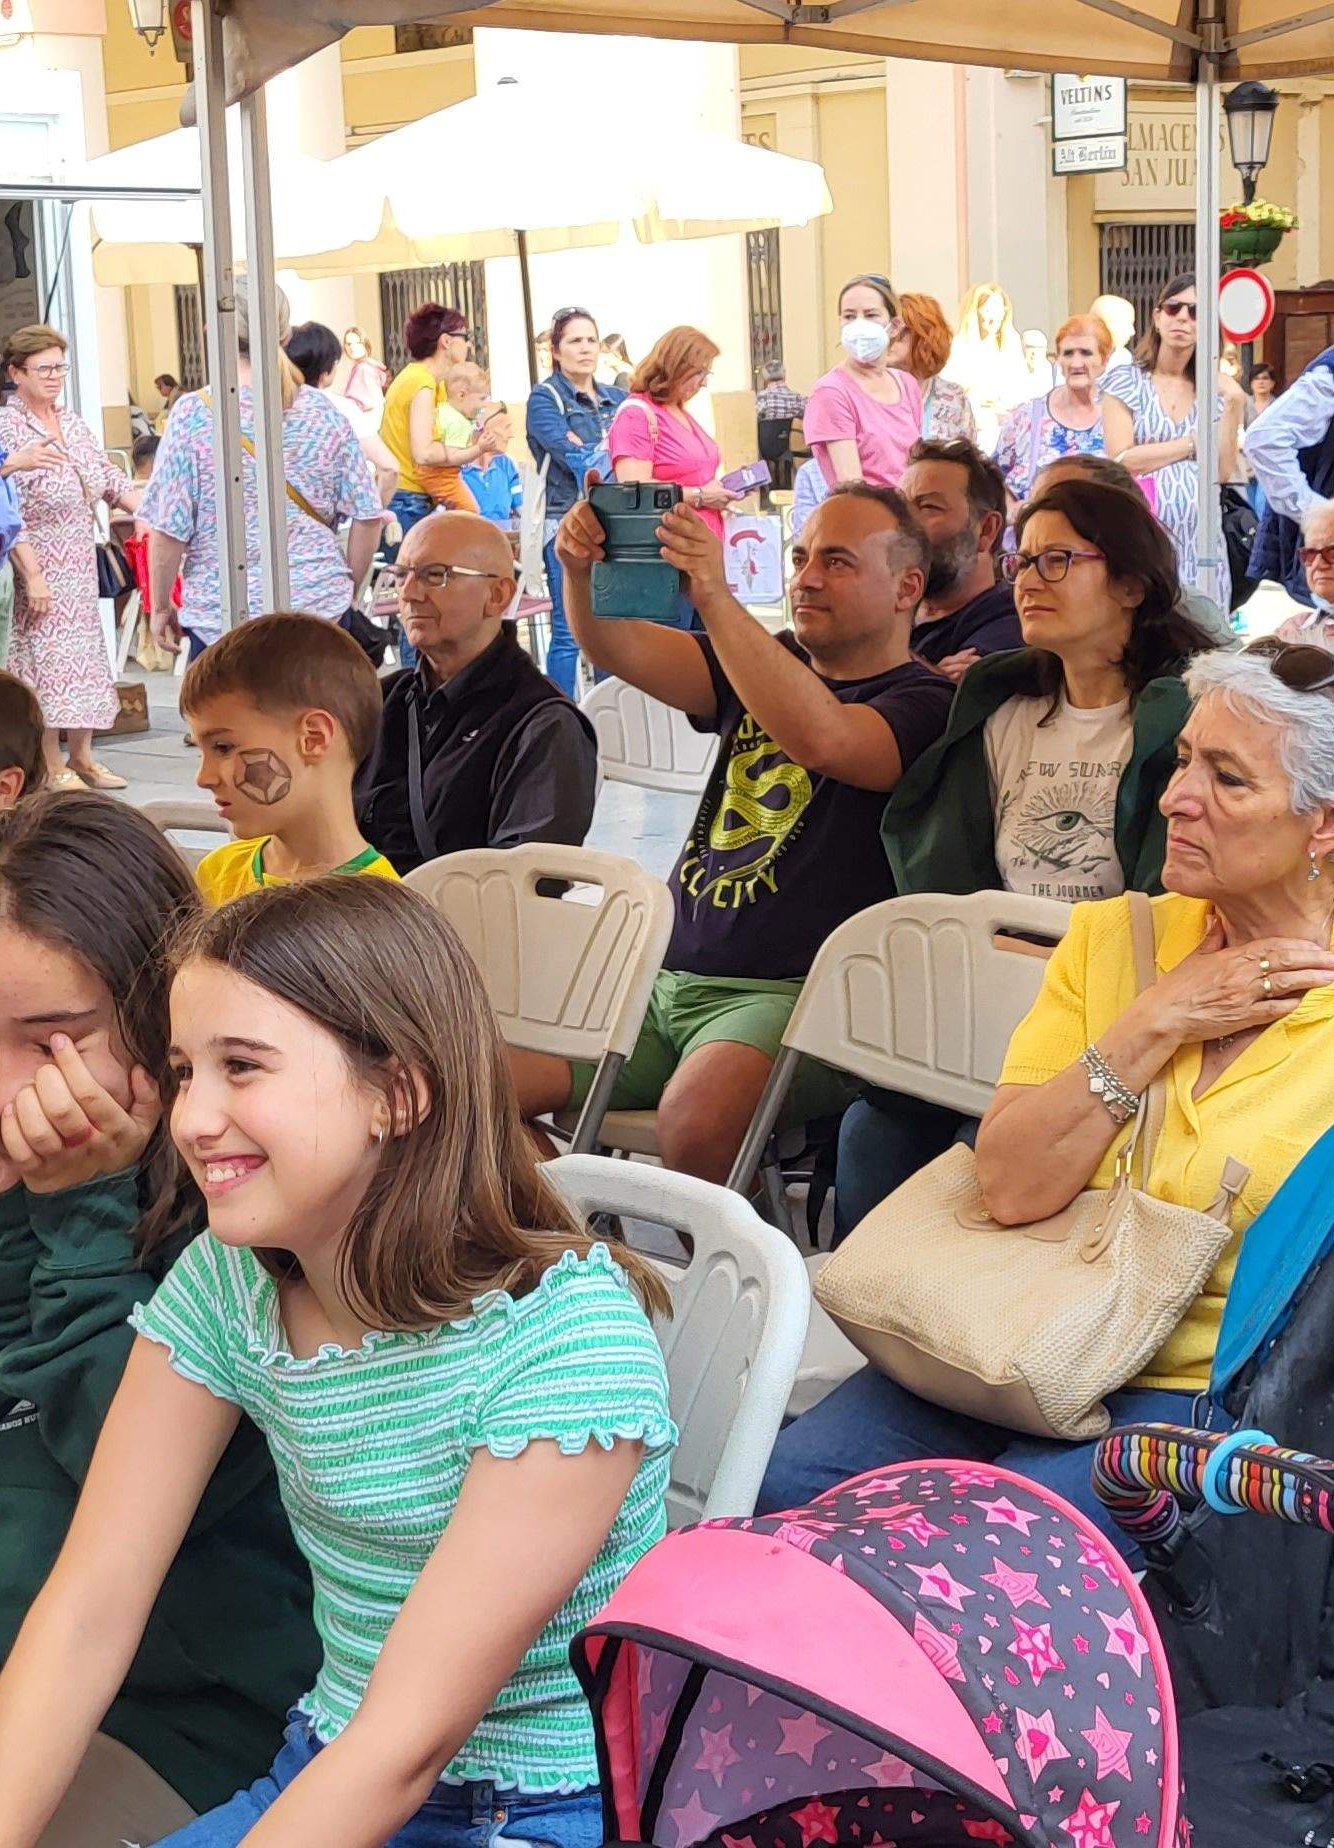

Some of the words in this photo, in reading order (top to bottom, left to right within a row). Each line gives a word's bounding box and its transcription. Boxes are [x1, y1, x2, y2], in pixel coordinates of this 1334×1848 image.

[1060, 84, 1113, 106] VELTINS
[1120, 157, 1158, 187] SAN
[1032, 883, 1052, 897] THE
